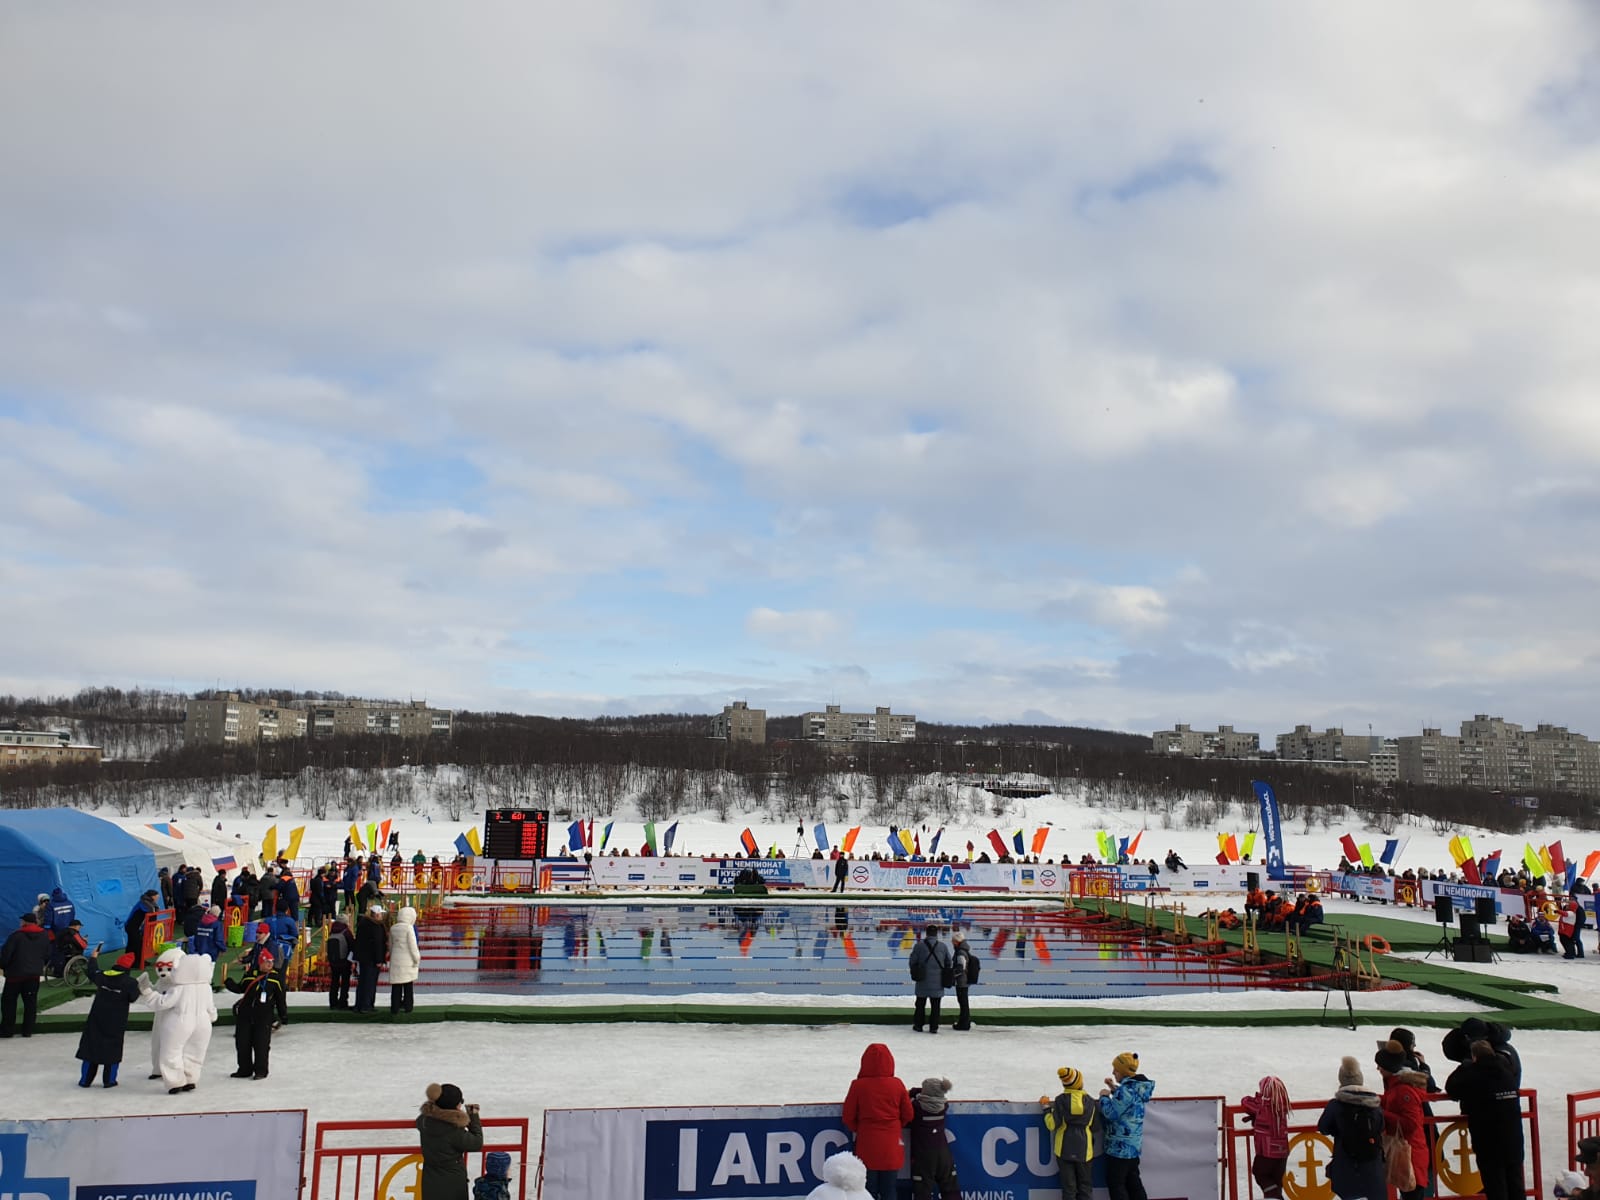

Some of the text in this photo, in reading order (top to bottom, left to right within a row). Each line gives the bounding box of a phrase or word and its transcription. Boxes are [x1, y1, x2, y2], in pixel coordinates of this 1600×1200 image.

[735, 860, 783, 869] ЧЕМПИОНАТ
[758, 868, 780, 876] МИРА
[908, 867, 940, 876] ВМЕСТЕ
[907, 876, 938, 887] ВПЕРЕД
[1445, 886, 1493, 898] ЧЕМПИОНАТ
